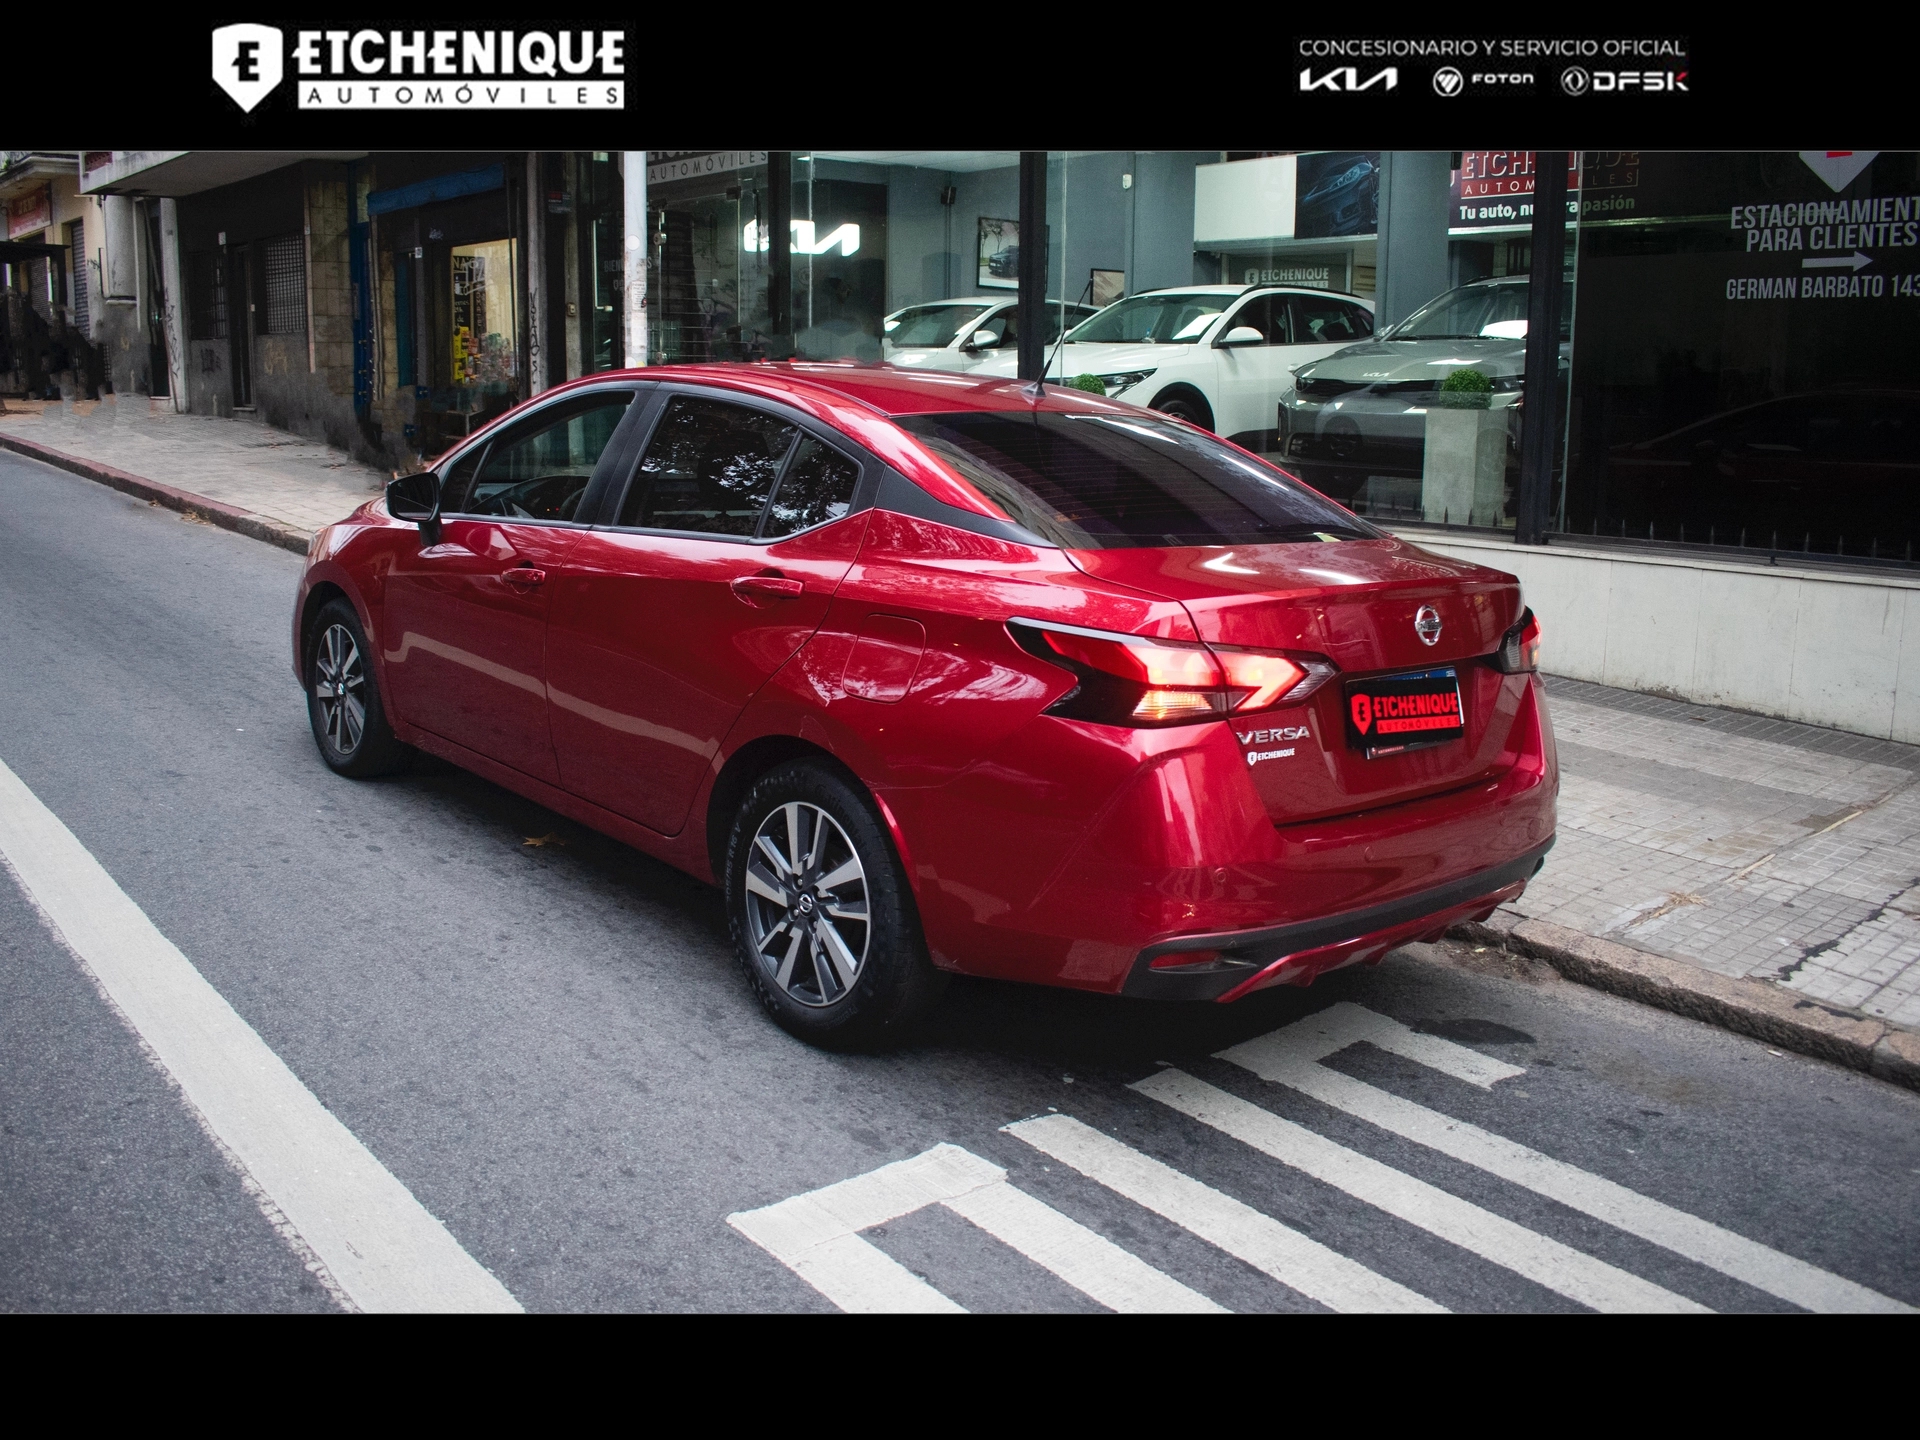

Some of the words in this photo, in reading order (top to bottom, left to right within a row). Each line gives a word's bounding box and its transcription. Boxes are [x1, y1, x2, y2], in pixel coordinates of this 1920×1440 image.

[650, 151, 767, 181] AUTOMÓVILES
[1460, 206, 1475, 220] Tu
[1479, 204, 1516, 219] auto,
[1582, 195, 1635, 214] pasión
[1746, 227, 1803, 252] PARA
[1809, 222, 1918, 250] CLIENTES
[1261, 267, 1329, 281] ETCHENIQUE
[1726, 277, 1797, 299] GERMAN
[1801, 275, 1884, 298] BARBATO
[1373, 693, 1459, 717] ETCHENIQUE
[1236, 726, 1310, 745] VERSA
